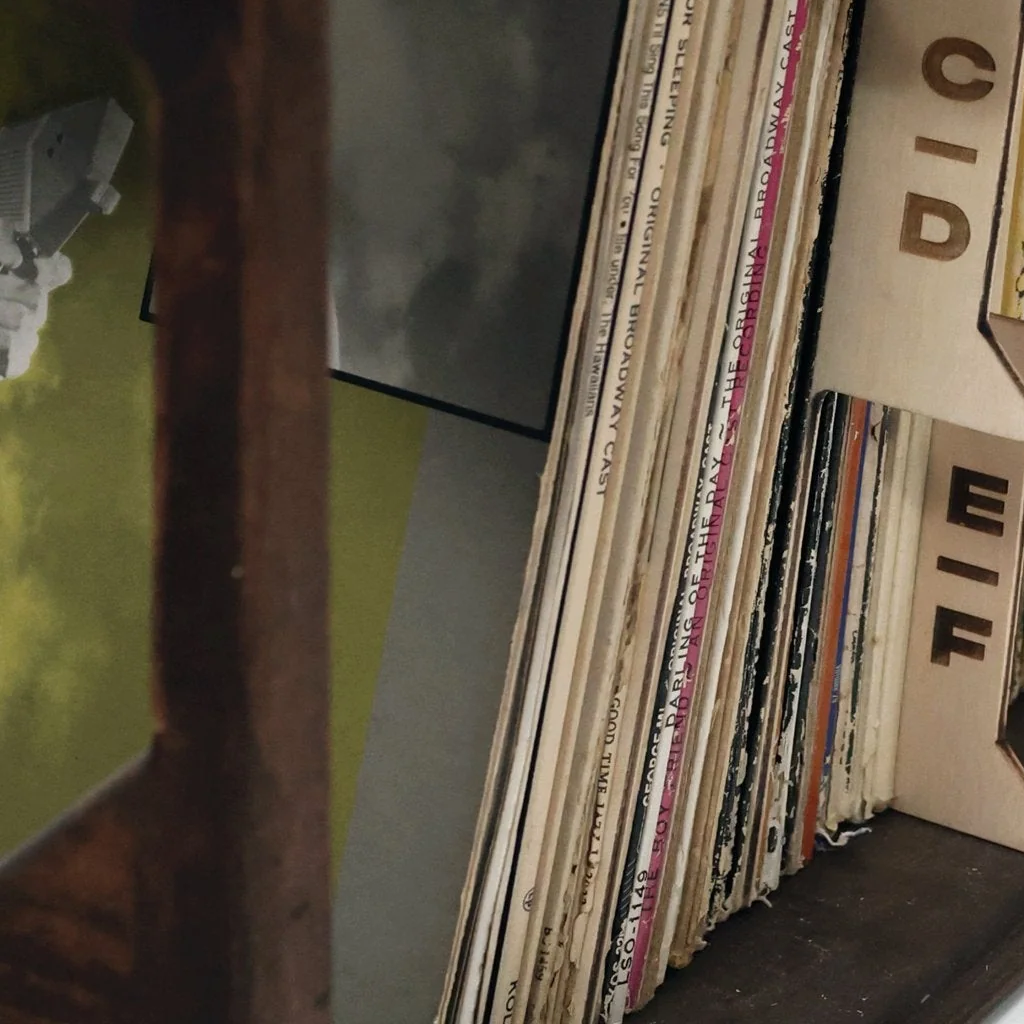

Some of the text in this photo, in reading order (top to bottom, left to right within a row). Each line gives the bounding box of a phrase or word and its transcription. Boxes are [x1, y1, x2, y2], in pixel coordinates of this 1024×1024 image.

[658, 38, 688, 147] SLEEPING
[900, 36, 997, 262] C D
[632, 185, 660, 295] ORIGINAL
[608, 302, 638, 430] BROADWAY
[696, 482, 727, 601] ORIGINAL
[733, 244, 767, 389] RECORDING
[596, 439, 615, 496] CAST
[617, 869, 648, 987] LSO-1149
[664, 617, 693, 729] DARLING
[687, 573, 701, 605] OF
[694, 516, 711, 564] THE
[704, 457, 722, 505] DAY
[721, 360, 738, 408] THE
[731, 237, 759, 349] ORIGINAL
[753, 80, 785, 219] BROADWAY
[778, 10, 797, 70] CAST
[930, 465, 1009, 667] E F
[597, 752, 612, 793] TIME
